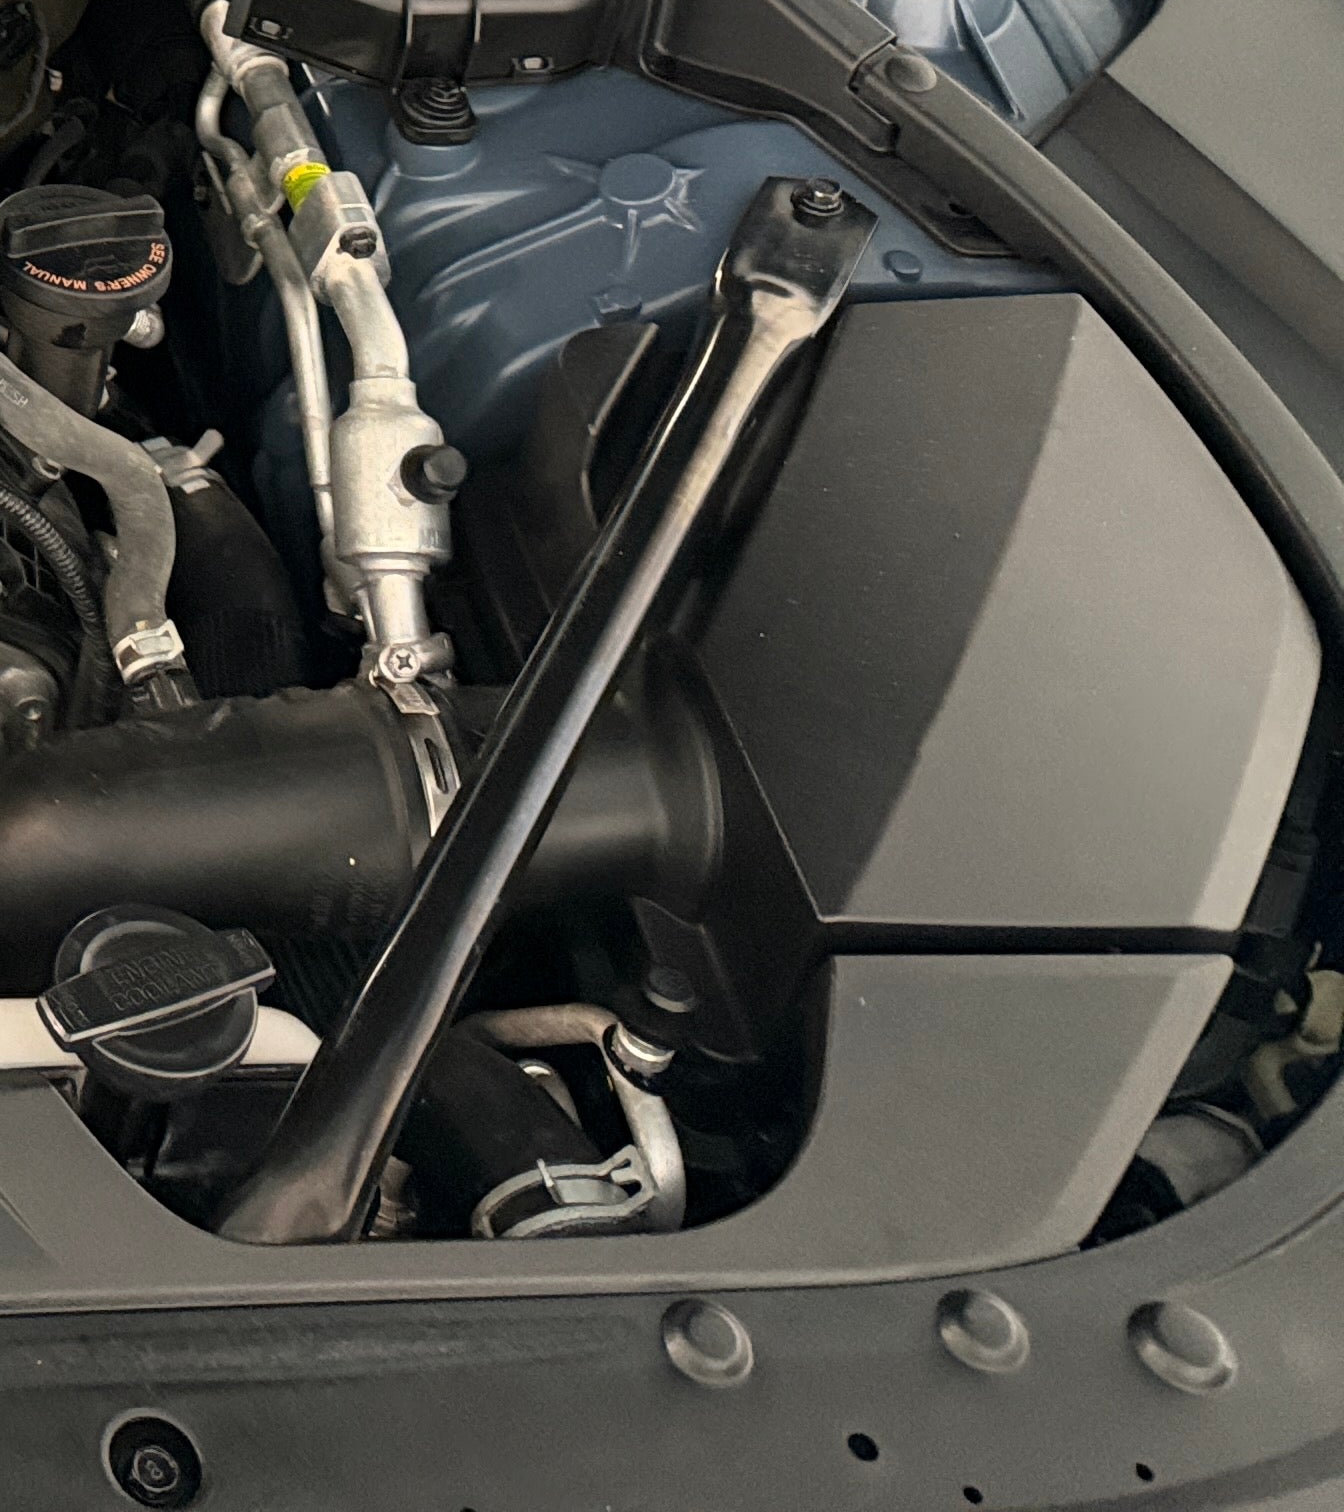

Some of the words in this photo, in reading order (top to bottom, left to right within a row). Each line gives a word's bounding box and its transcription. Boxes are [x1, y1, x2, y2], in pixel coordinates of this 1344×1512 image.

[150, 242, 166, 265] SEE
[22, 260, 87, 291] MANUAL
[95, 263, 157, 292] OWNER'S
[109, 962, 223, 1012] COOLANT
